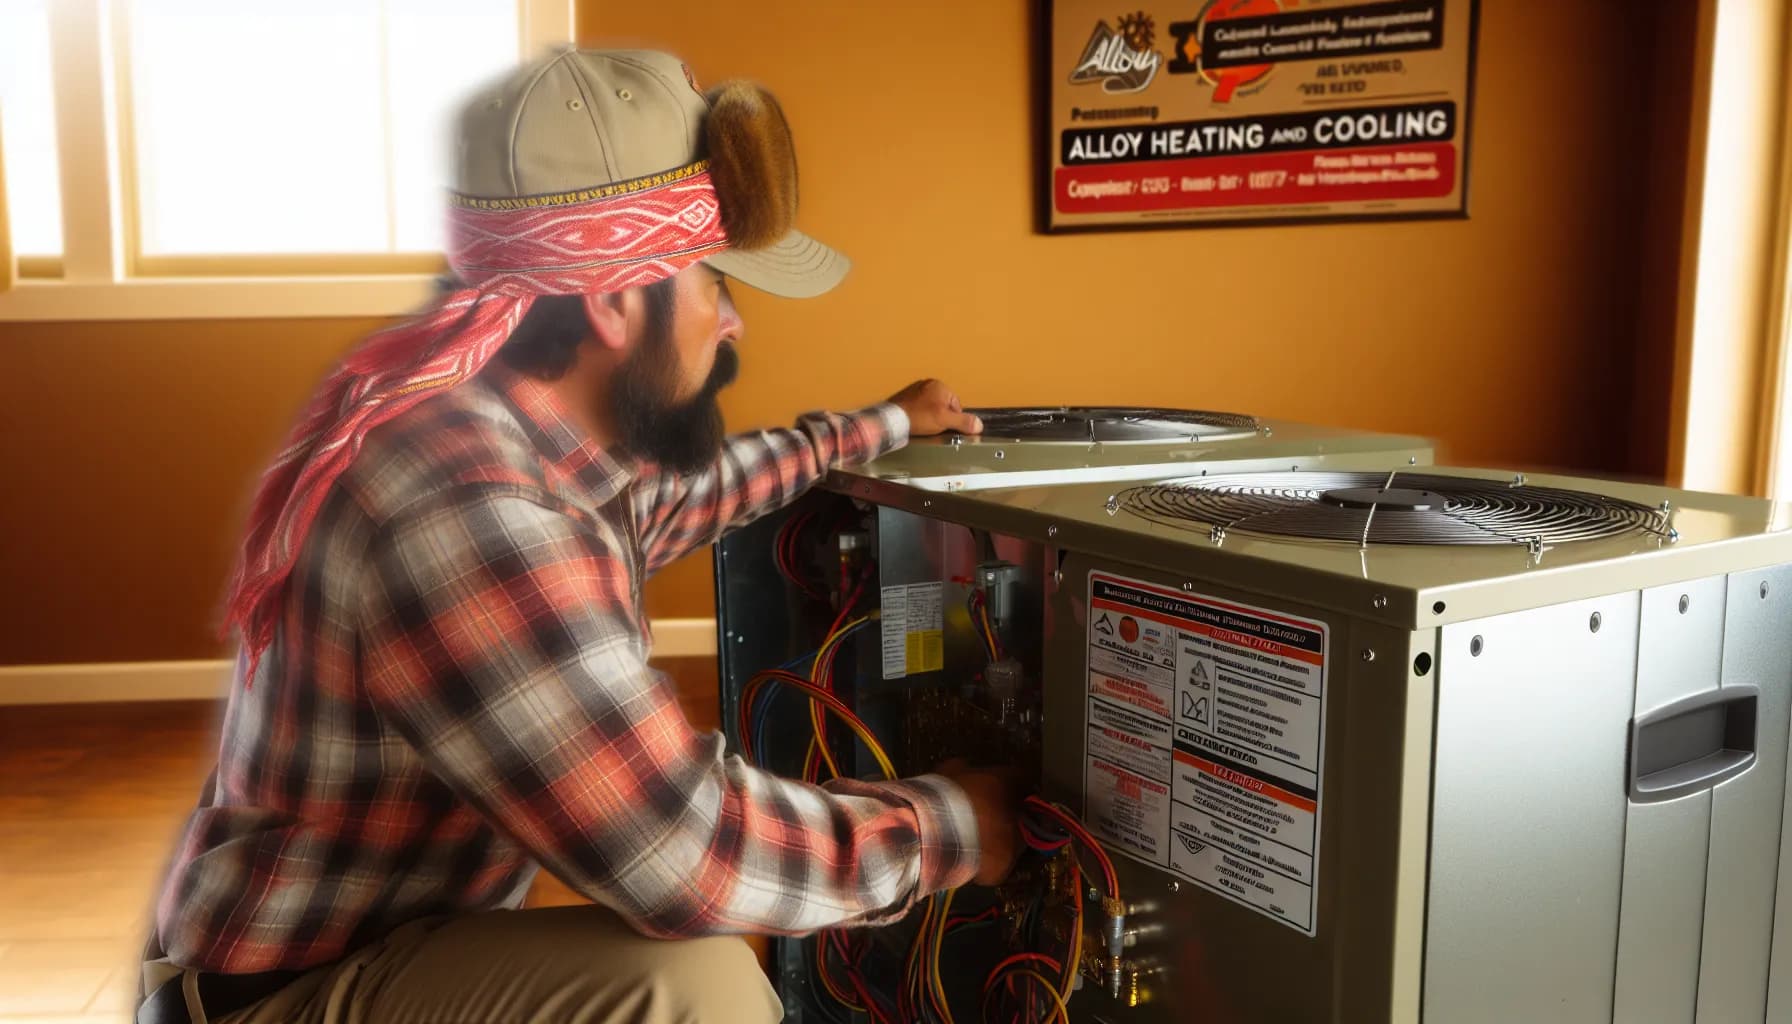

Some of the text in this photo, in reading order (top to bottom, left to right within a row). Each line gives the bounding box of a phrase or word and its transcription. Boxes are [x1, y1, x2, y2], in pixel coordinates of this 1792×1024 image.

[1068, 110, 1447, 161] ALLOY HEATING AND COOLING
